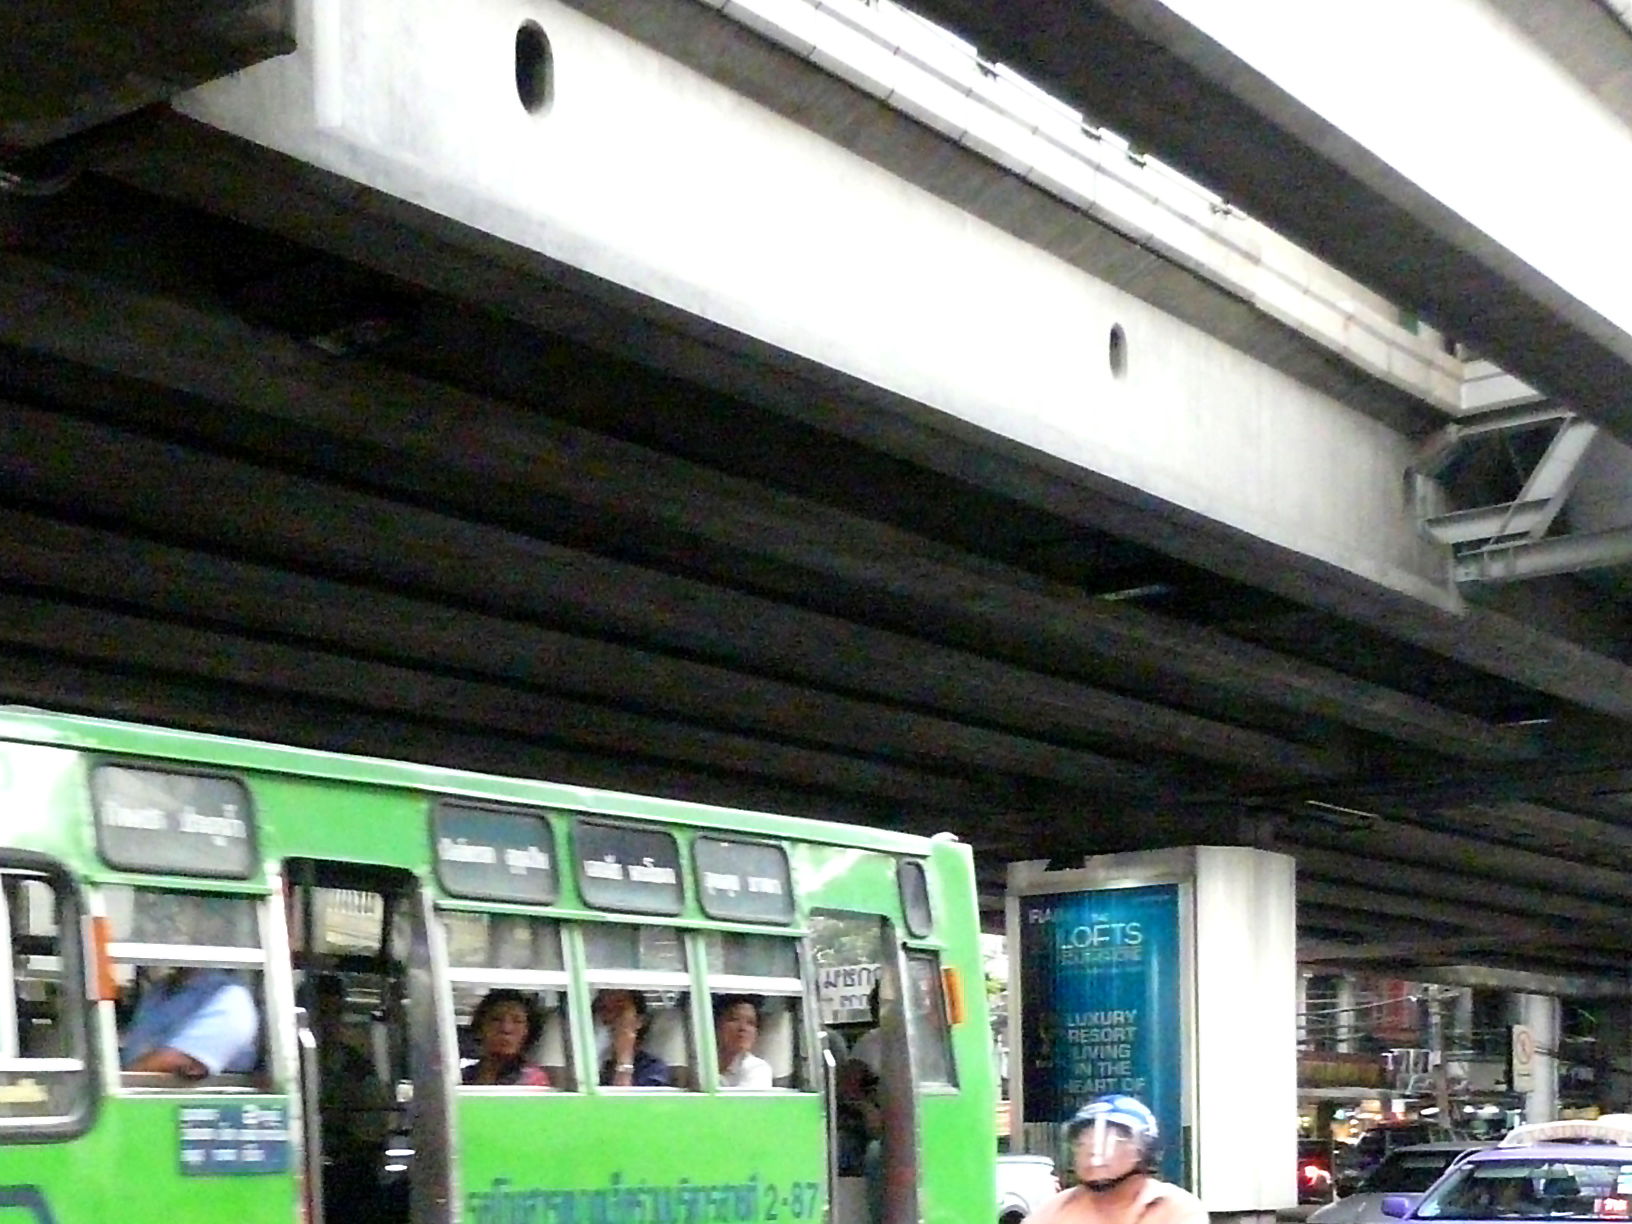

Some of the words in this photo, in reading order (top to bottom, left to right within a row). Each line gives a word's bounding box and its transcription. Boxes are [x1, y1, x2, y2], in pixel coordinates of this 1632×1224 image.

[1068, 1009, 1137, 1027] LUXURY
[1068, 1026, 1137, 1044] RESORT
[1098, 1060, 1132, 1077] THE
[764, 1181, 820, 1222] 2-87
